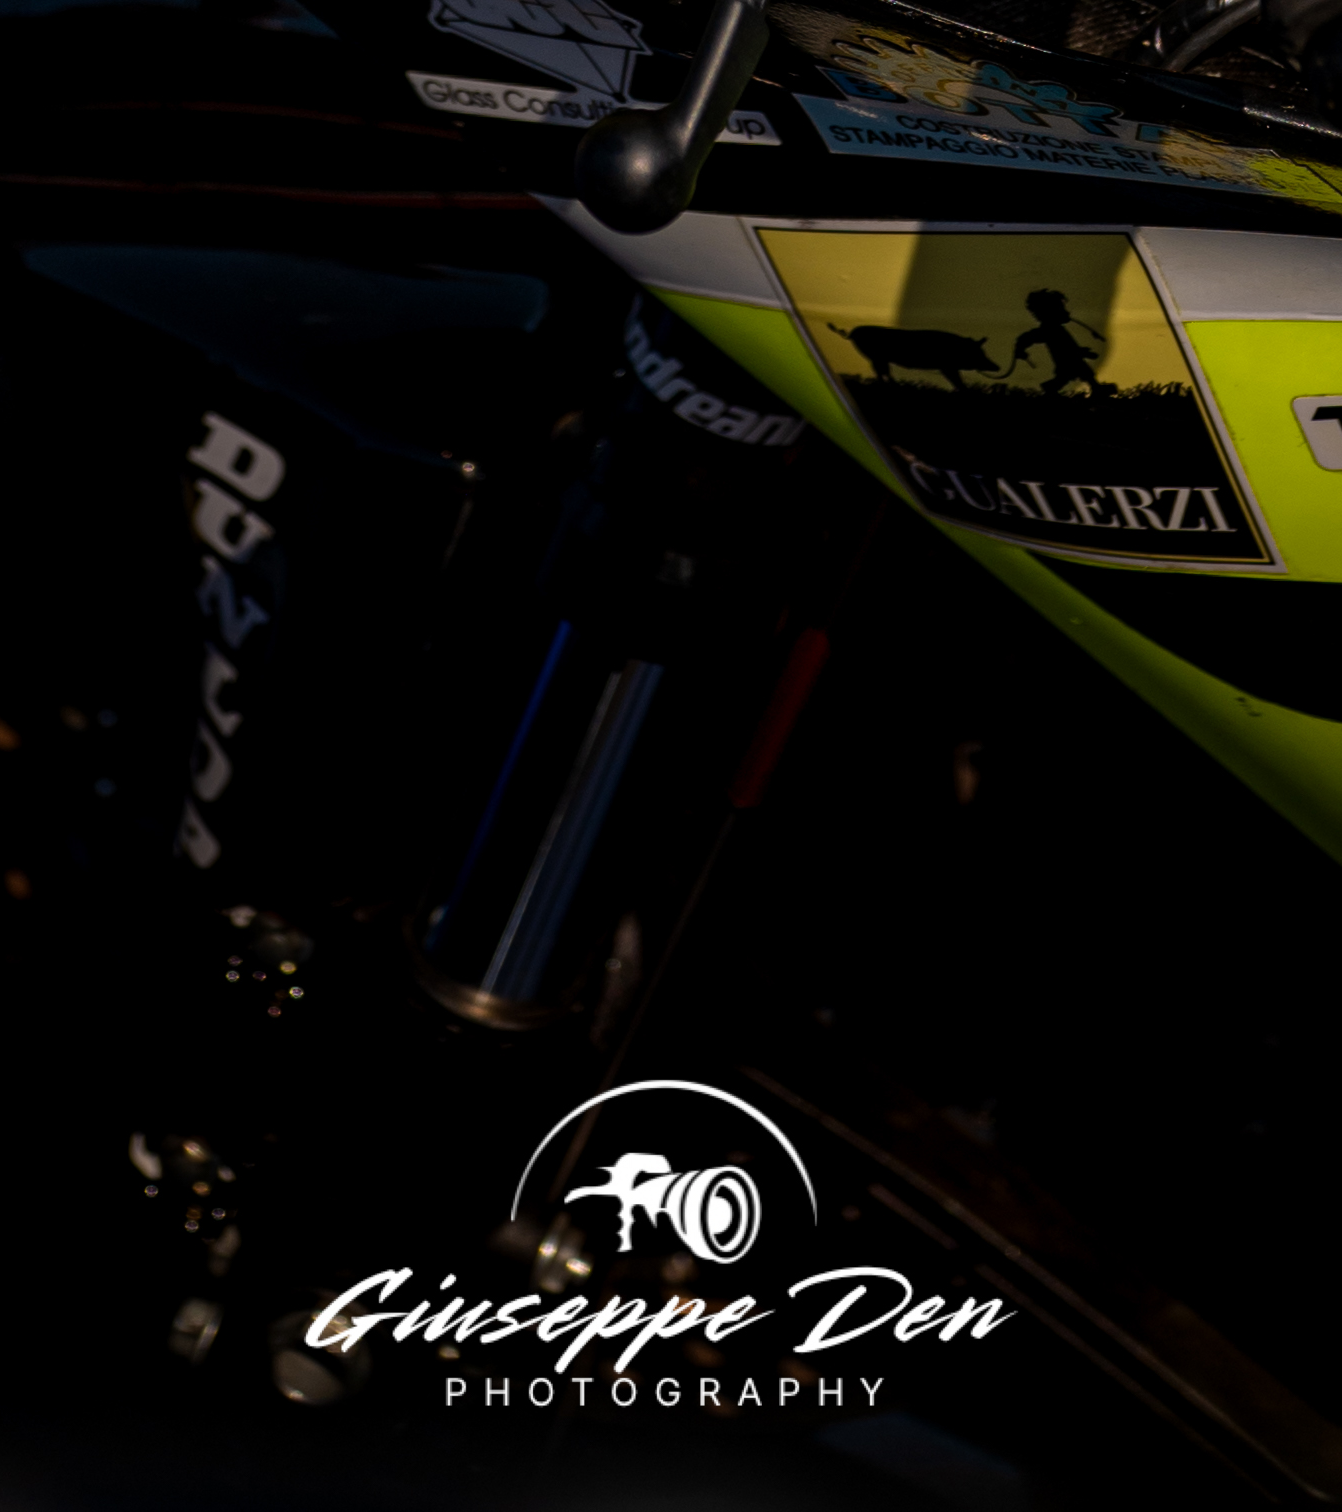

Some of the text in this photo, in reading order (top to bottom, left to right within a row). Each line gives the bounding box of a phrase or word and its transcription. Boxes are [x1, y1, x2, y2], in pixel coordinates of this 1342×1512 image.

[422, 79, 498, 110] Glass
[828, 123, 1019, 160] STAMPAGGIO
[896, 114, 1109, 155] COSTRUZIONE
[909, 460, 1239, 533] GUALERZI
